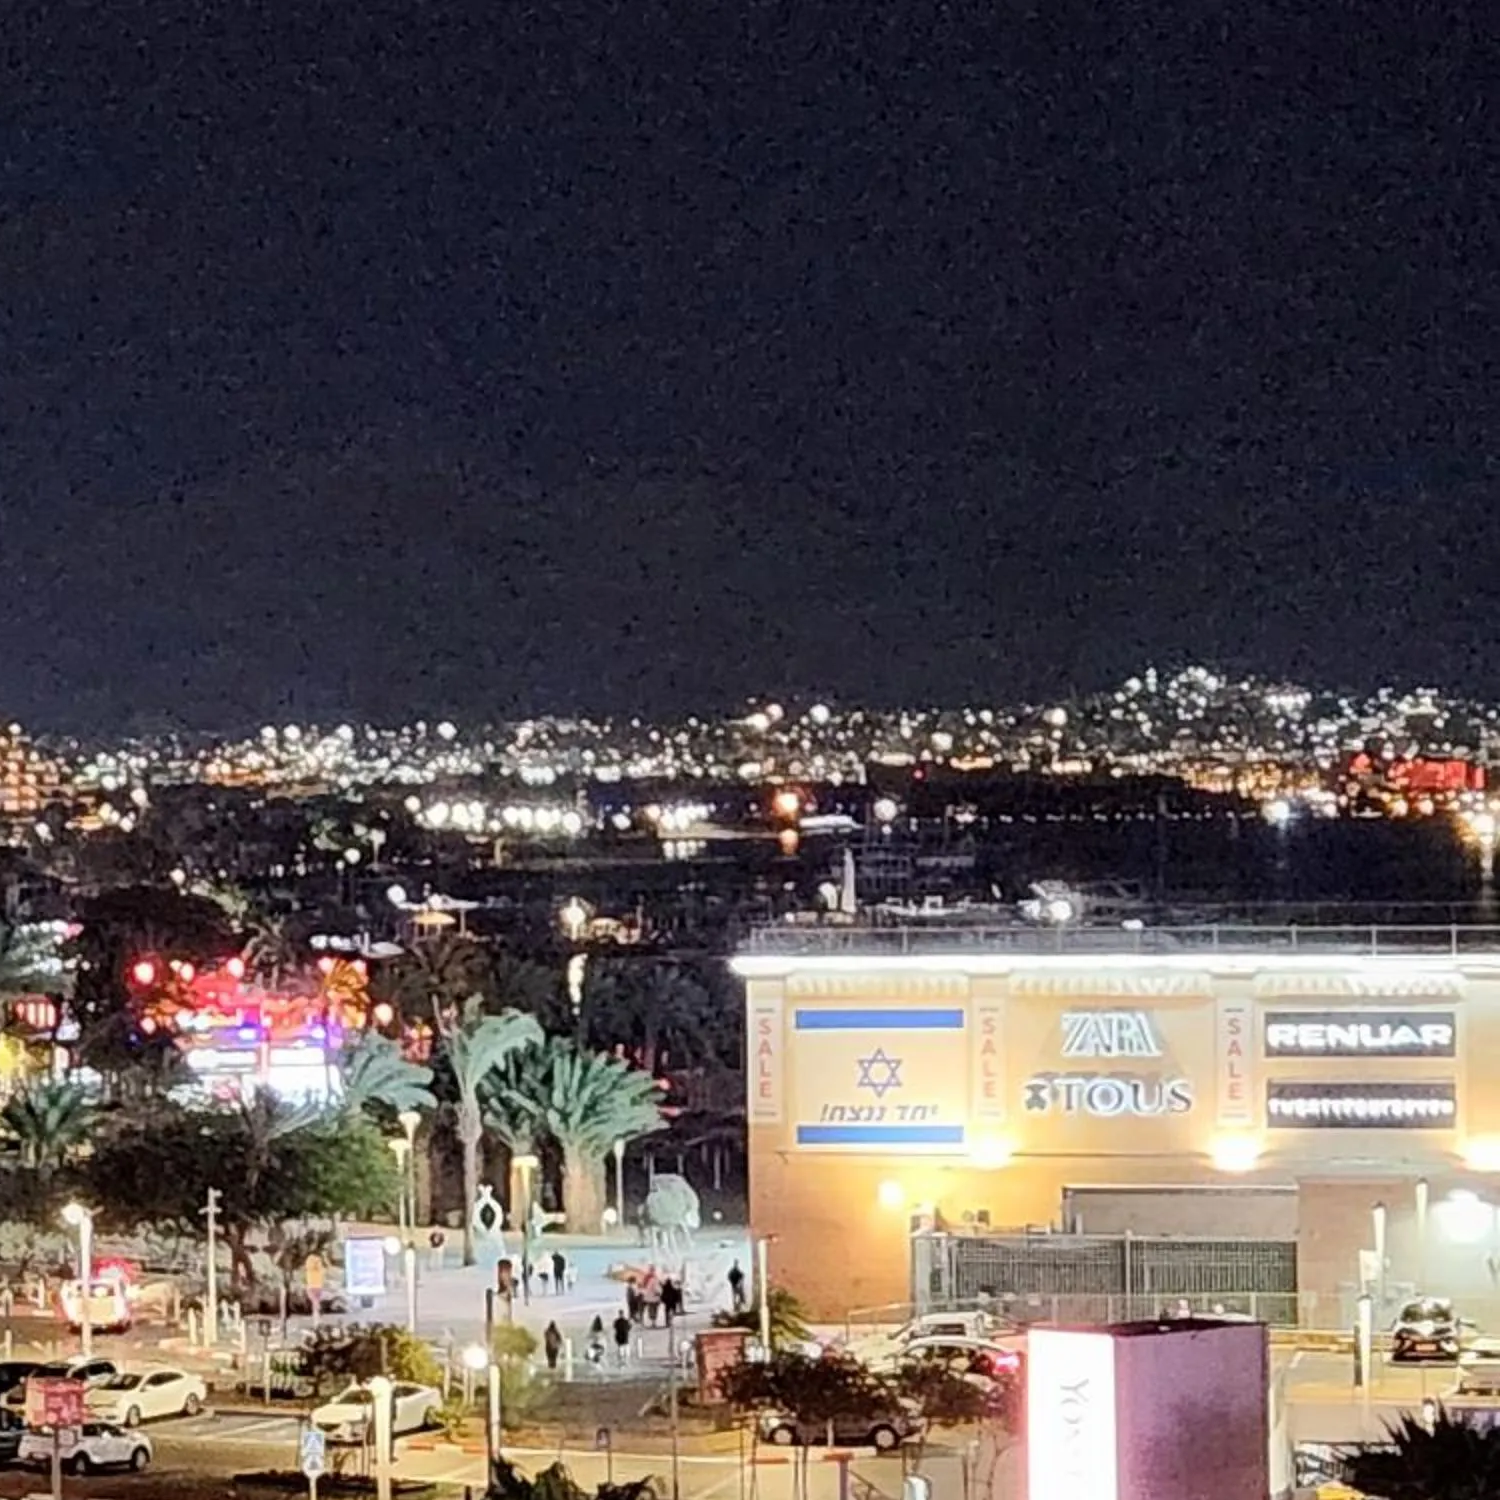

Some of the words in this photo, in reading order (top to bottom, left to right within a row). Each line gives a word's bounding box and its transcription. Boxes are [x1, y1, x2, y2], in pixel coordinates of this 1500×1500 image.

[1060, 1012, 1162, 1057] ZARA
[1267, 1023, 1453, 1048] RENUAR
[758, 1018, 773, 1098] SALE
[982, 1017, 997, 1098] SALE
[1227, 1017, 1243, 1100] SALE
[895, 1104, 939, 1121] יחד
[1053, 1077, 1192, 1117] TOUS
